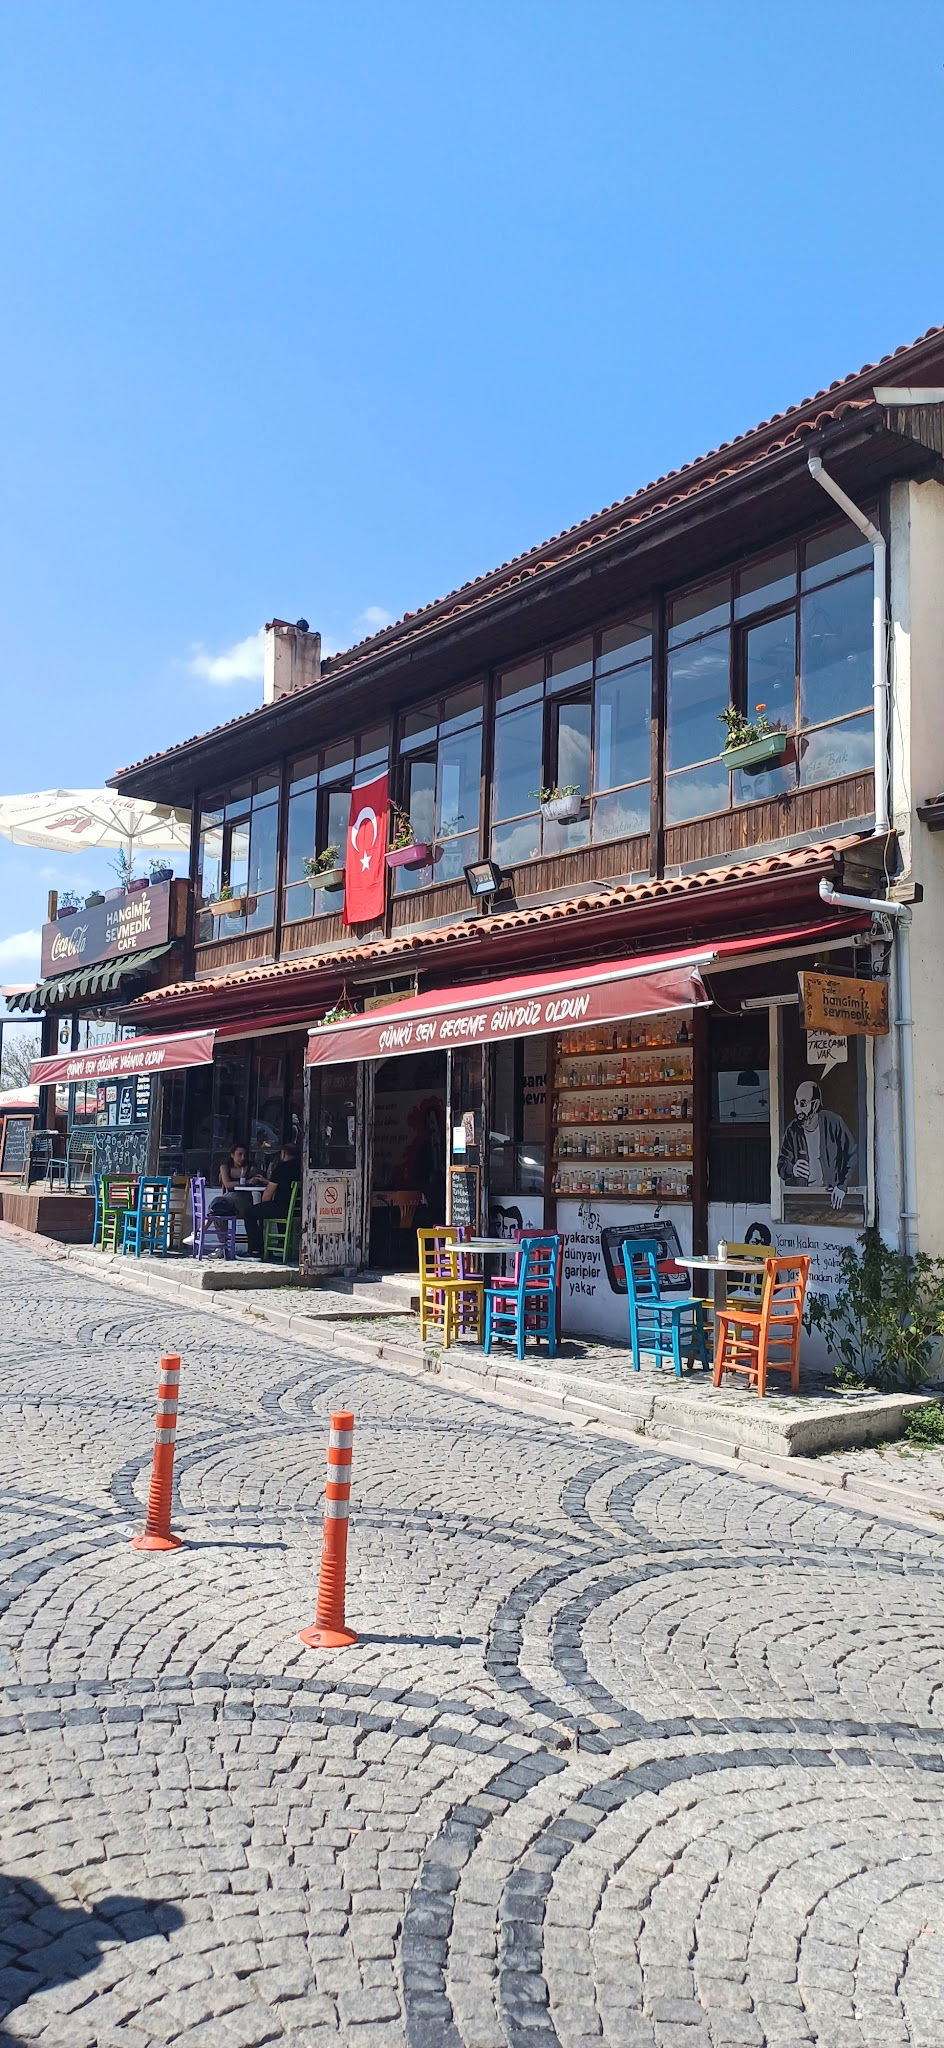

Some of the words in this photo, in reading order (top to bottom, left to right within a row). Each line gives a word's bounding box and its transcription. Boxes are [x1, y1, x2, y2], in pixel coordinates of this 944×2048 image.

[117, 937, 137, 951] CAFE
[379, 1023, 413, 1052] ÇÜNKÜ
[415, 1022, 436, 1043] SEN
[439, 1014, 487, 1040] GECEME
[490, 1001, 541, 1031] GÜNDÜZ
[544, 993, 591, 1020] OLDUN
[817, 1049, 837, 1060] VAR
[565, 1232, 601, 1248] yakarsa
[797, 1235, 819, 1249] kalan
[565, 1247, 601, 1264] dünyayı
[565, 1264, 601, 1280] garipler
[569, 1280, 597, 1297] yakar
